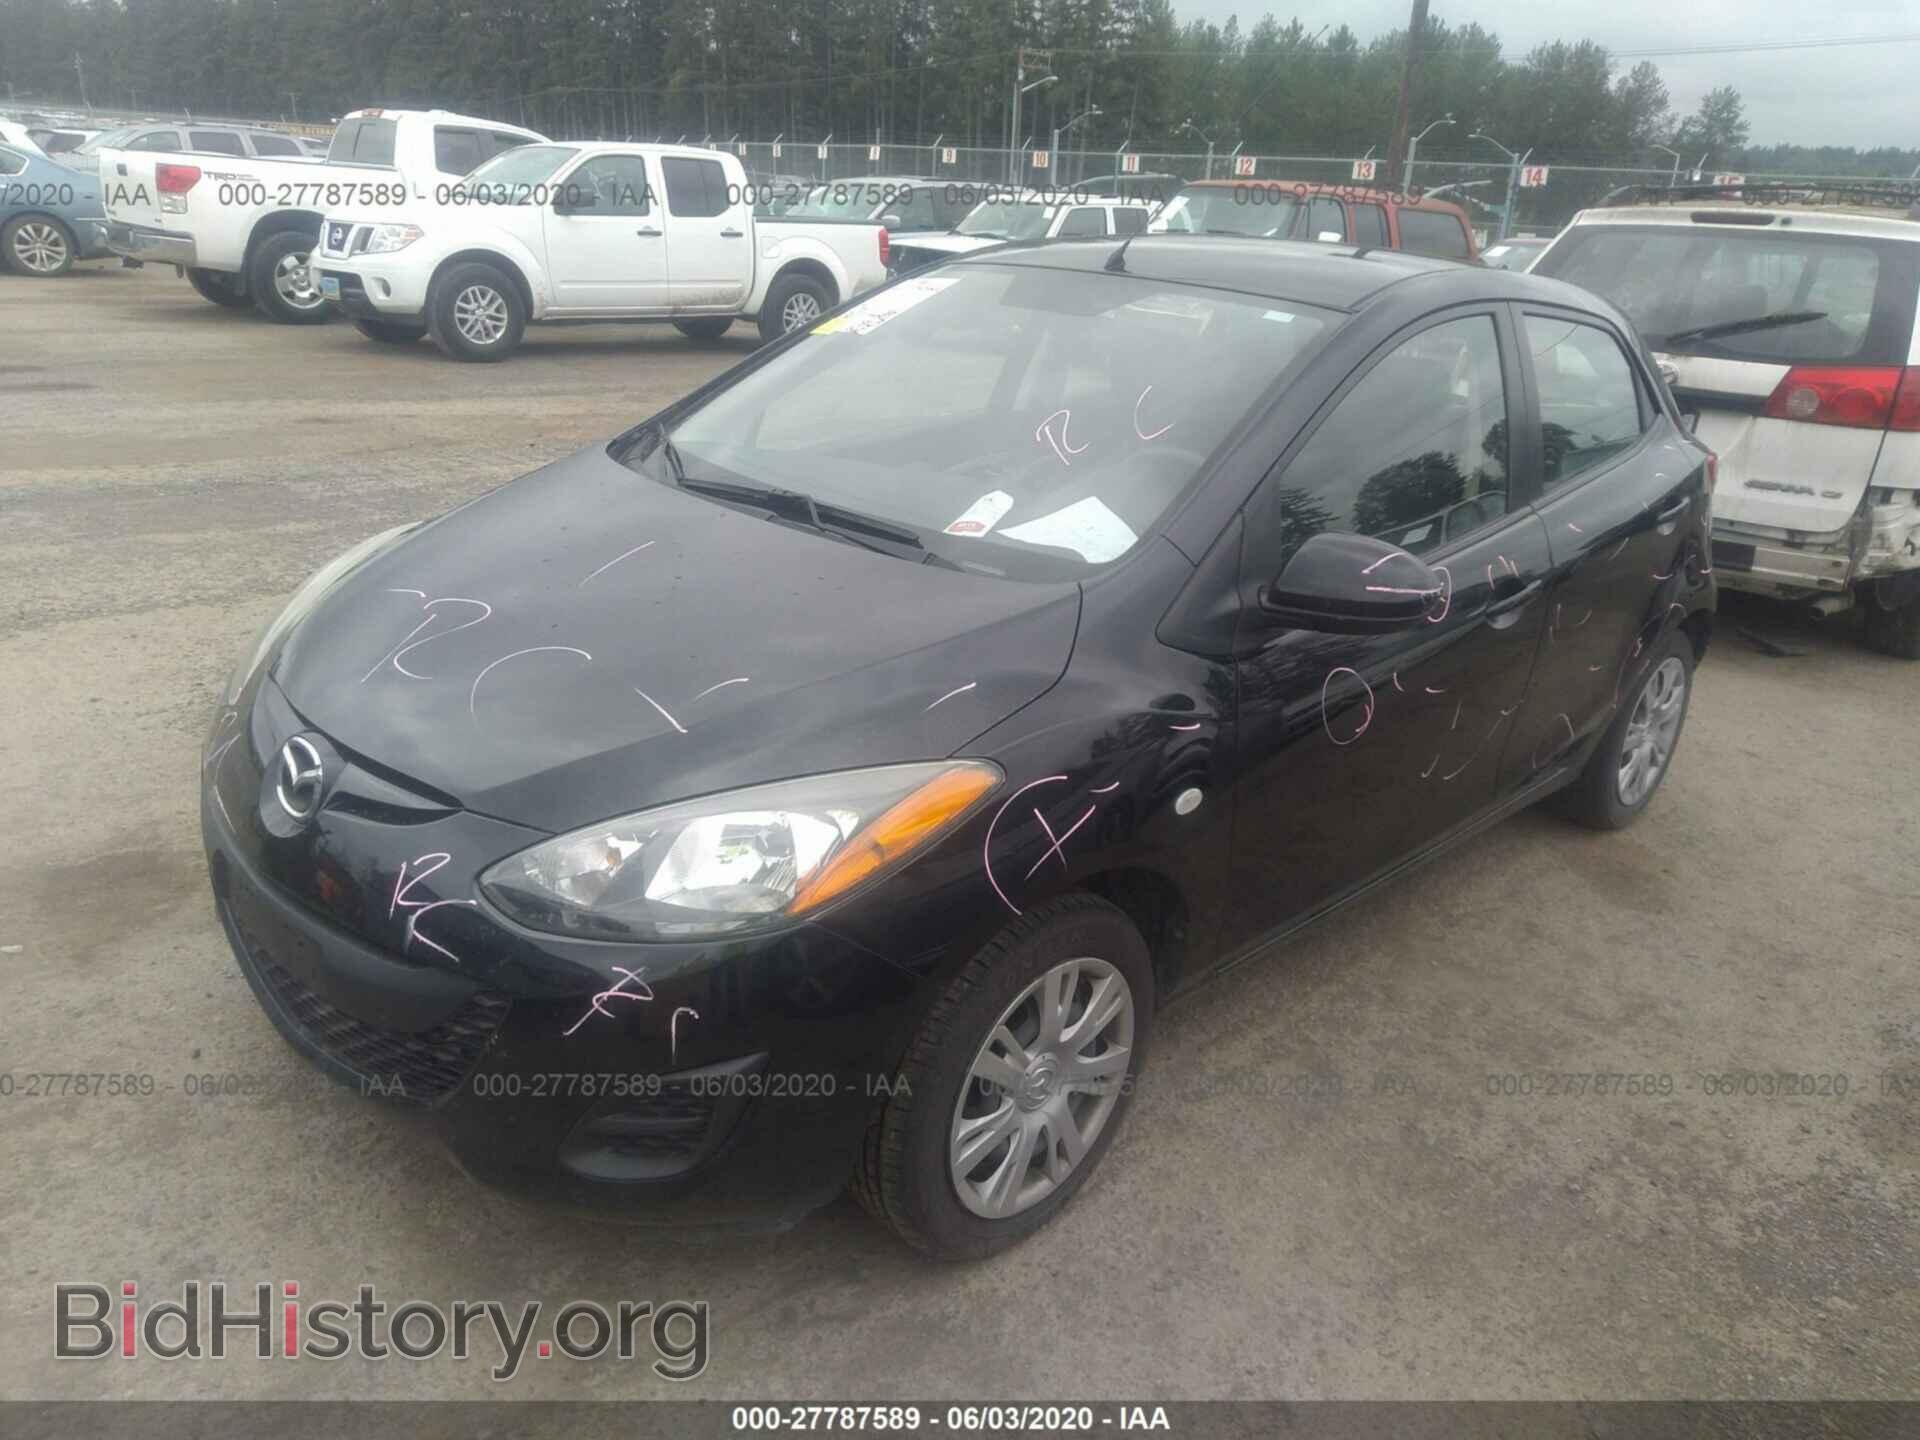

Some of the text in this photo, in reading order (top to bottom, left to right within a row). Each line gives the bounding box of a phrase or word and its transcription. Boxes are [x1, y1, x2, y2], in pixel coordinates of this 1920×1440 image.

[1239, 158, 1252, 174] 12
[1356, 161, 1371, 177] 13
[1525, 167, 1543, 186] 14
